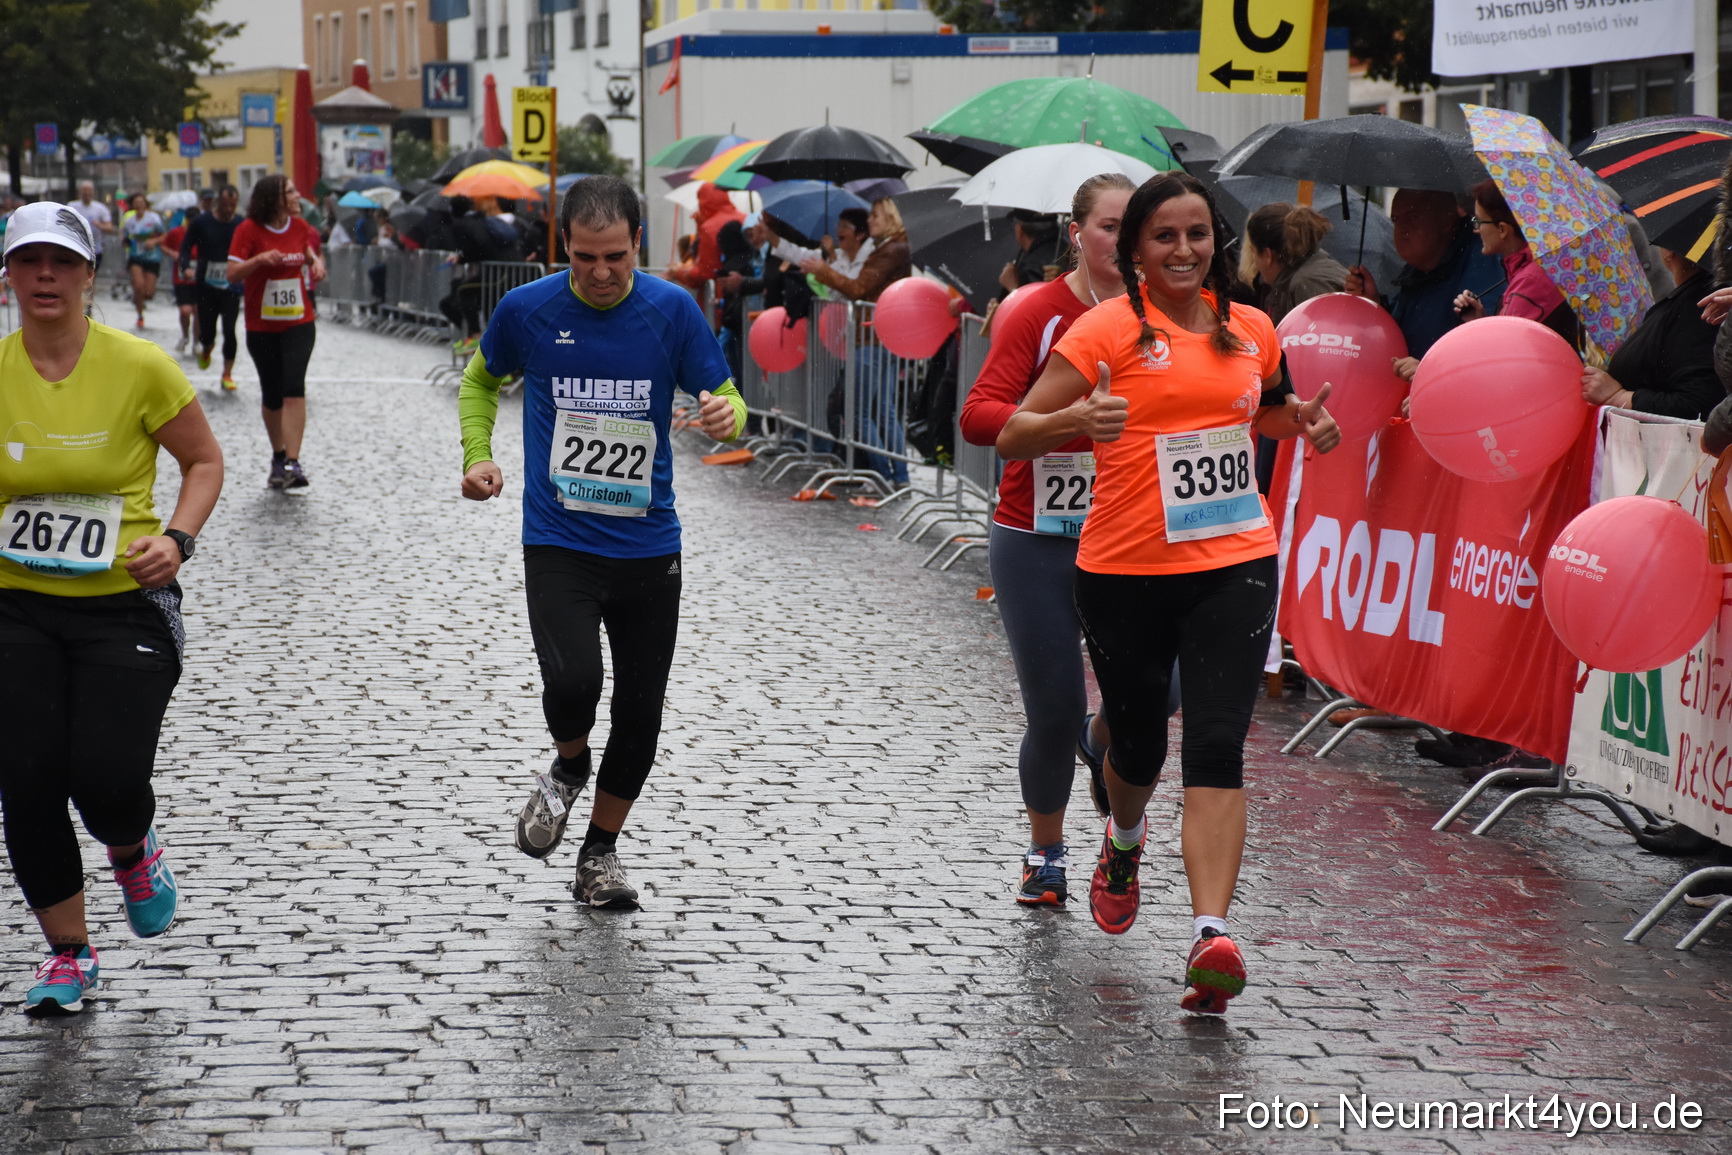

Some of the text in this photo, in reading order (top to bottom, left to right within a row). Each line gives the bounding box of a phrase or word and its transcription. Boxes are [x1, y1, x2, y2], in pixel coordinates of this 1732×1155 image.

[1233, 0, 1295, 53] C
[516, 89, 551, 103] Block
[524, 110, 545, 144] D
[271, 289, 296, 305] 136
[551, 376, 652, 400] HUBER
[573, 401, 647, 410] TECHNOLOGY
[623, 411, 647, 419] Solutions
[564, 421, 598, 432] NeuerMarkt
[604, 420, 650, 437] BOCK
[561, 436, 647, 480] 2222
[1166, 442, 1203, 453] NeuerMarkt
[1172, 450, 1250, 499] 3398
[568, 482, 632, 505] Christoph
[1184, 502, 1238, 524] KERSTIN
[8, 509, 107, 559] 2670
